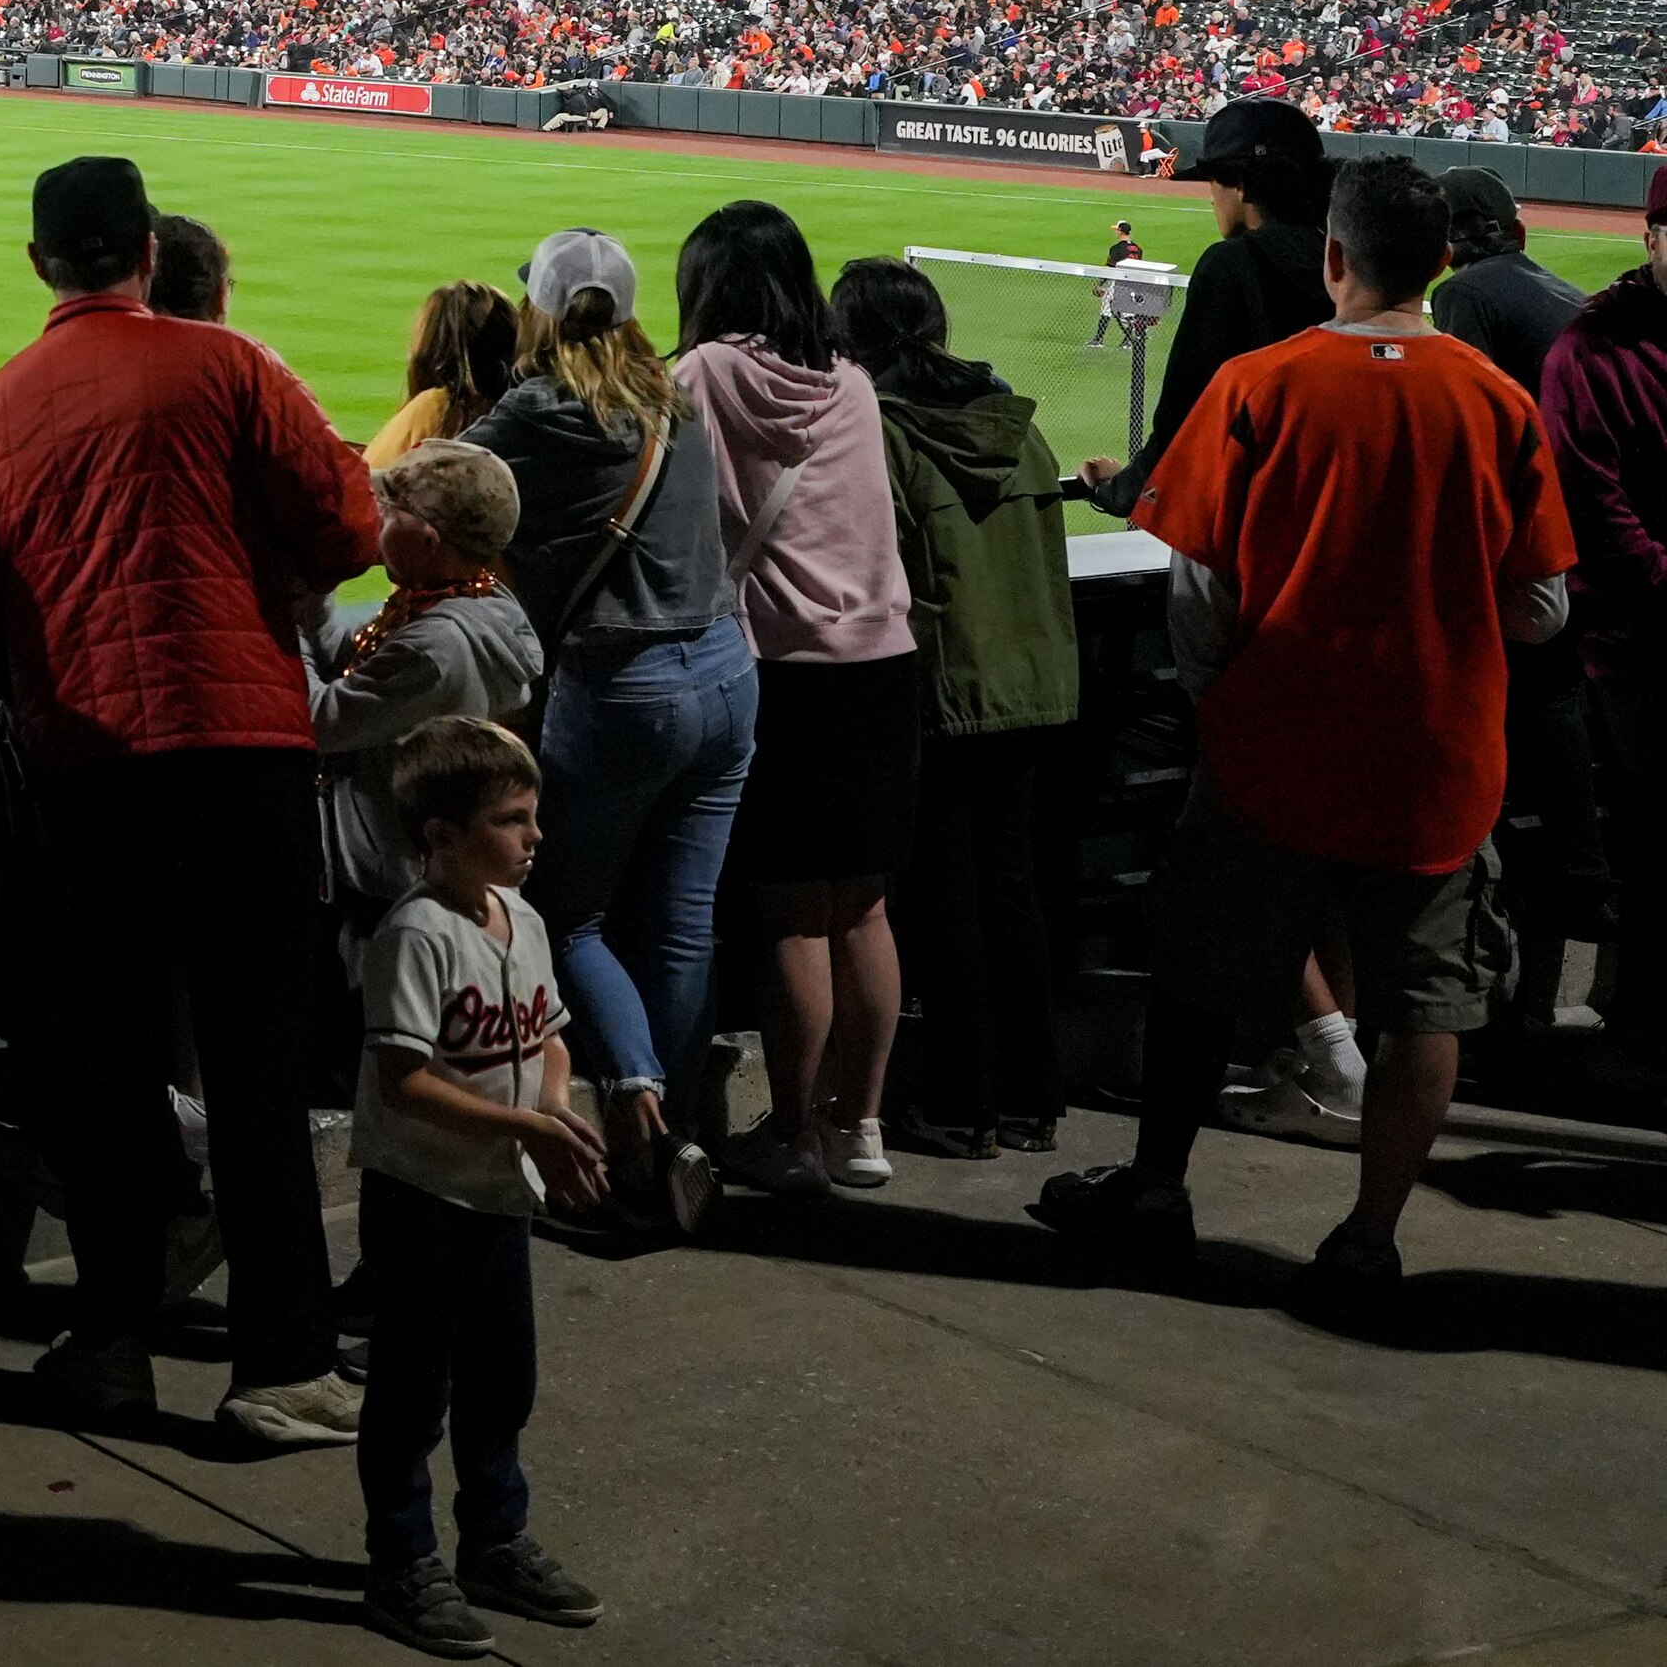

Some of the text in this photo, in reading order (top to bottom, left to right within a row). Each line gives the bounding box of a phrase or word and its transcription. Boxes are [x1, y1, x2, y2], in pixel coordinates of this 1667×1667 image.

[81, 70, 121, 80] PENNINGTON
[896, 120, 1097, 154] GREAT TASTE. 96 CALORIES.
[1101, 133, 1125, 158] Lite
